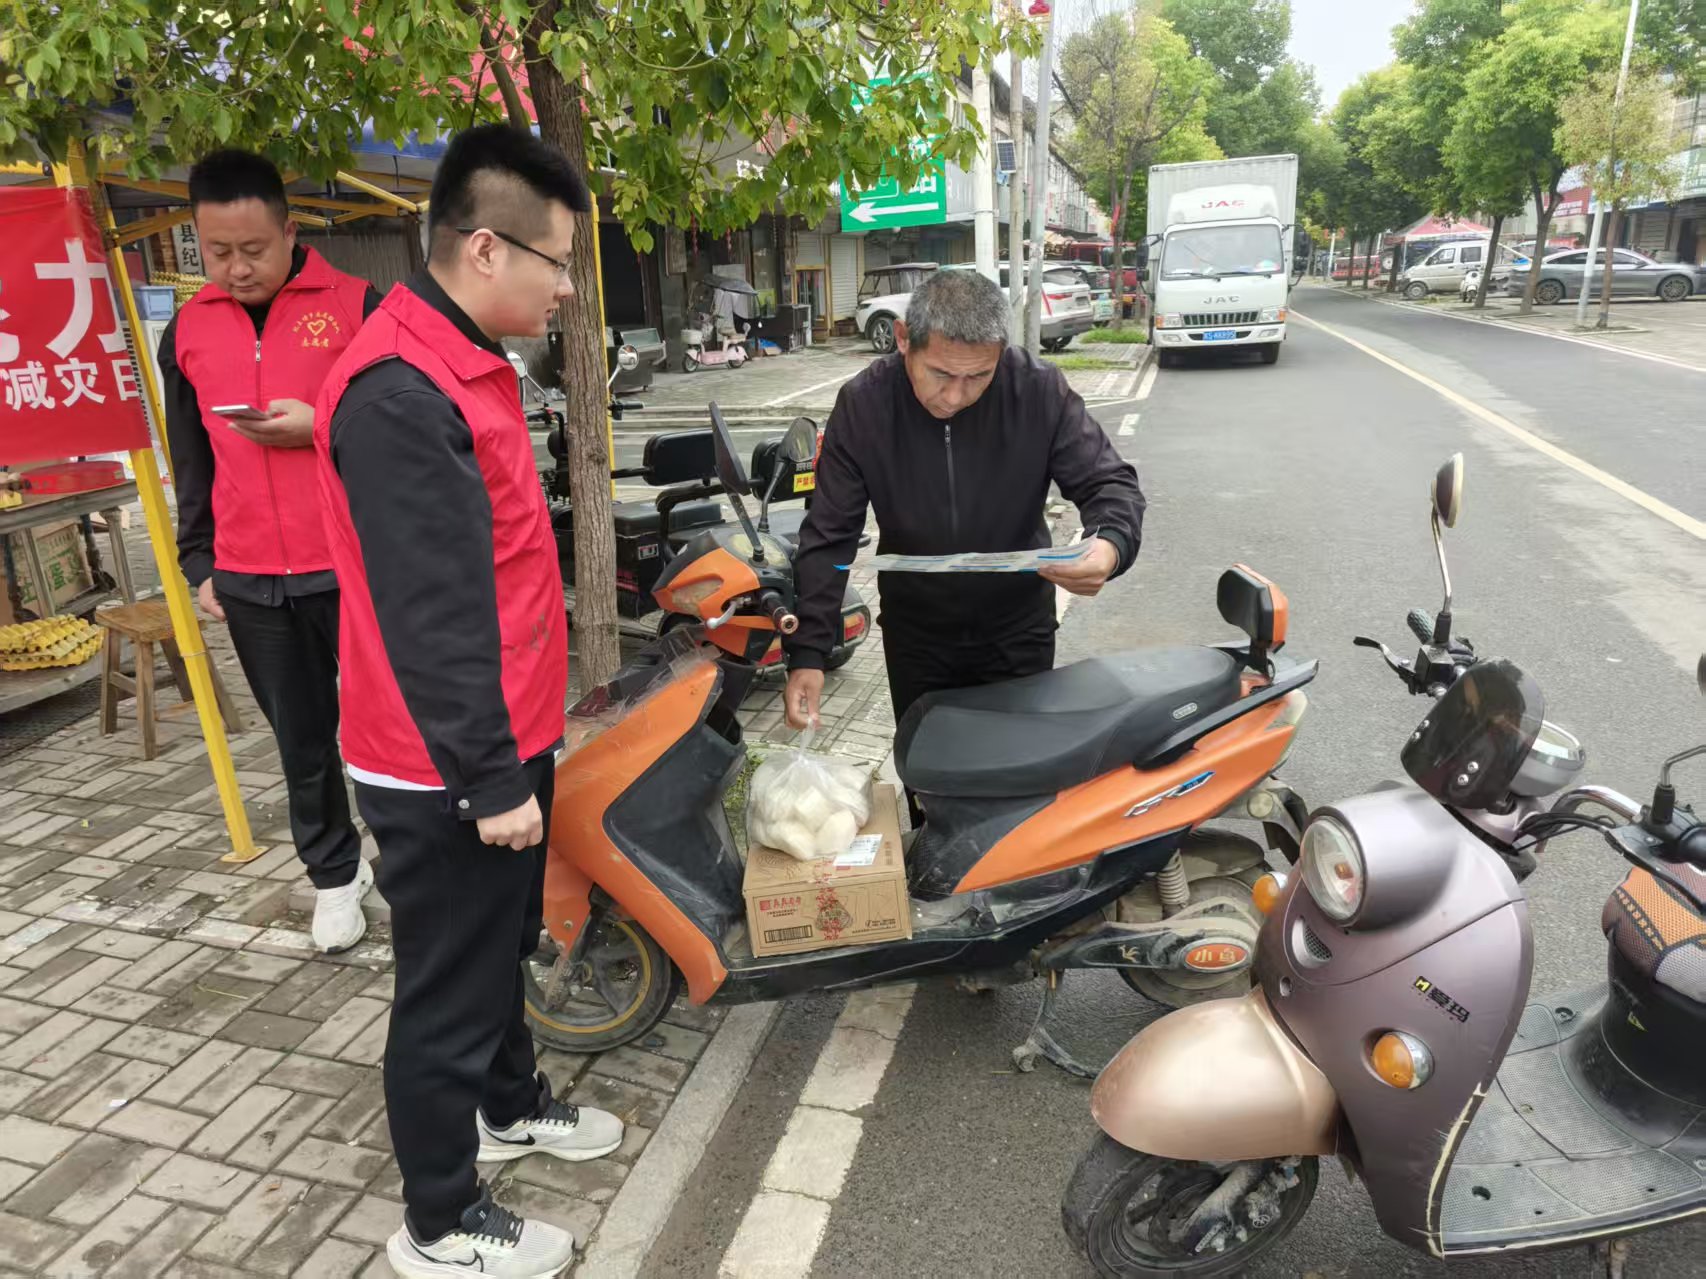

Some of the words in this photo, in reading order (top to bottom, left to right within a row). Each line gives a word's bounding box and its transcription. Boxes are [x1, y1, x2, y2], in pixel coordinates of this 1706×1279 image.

[180, 224, 199, 275] 县纪
[0, 237, 129, 363] 力
[1203, 295, 1239, 304] JAC
